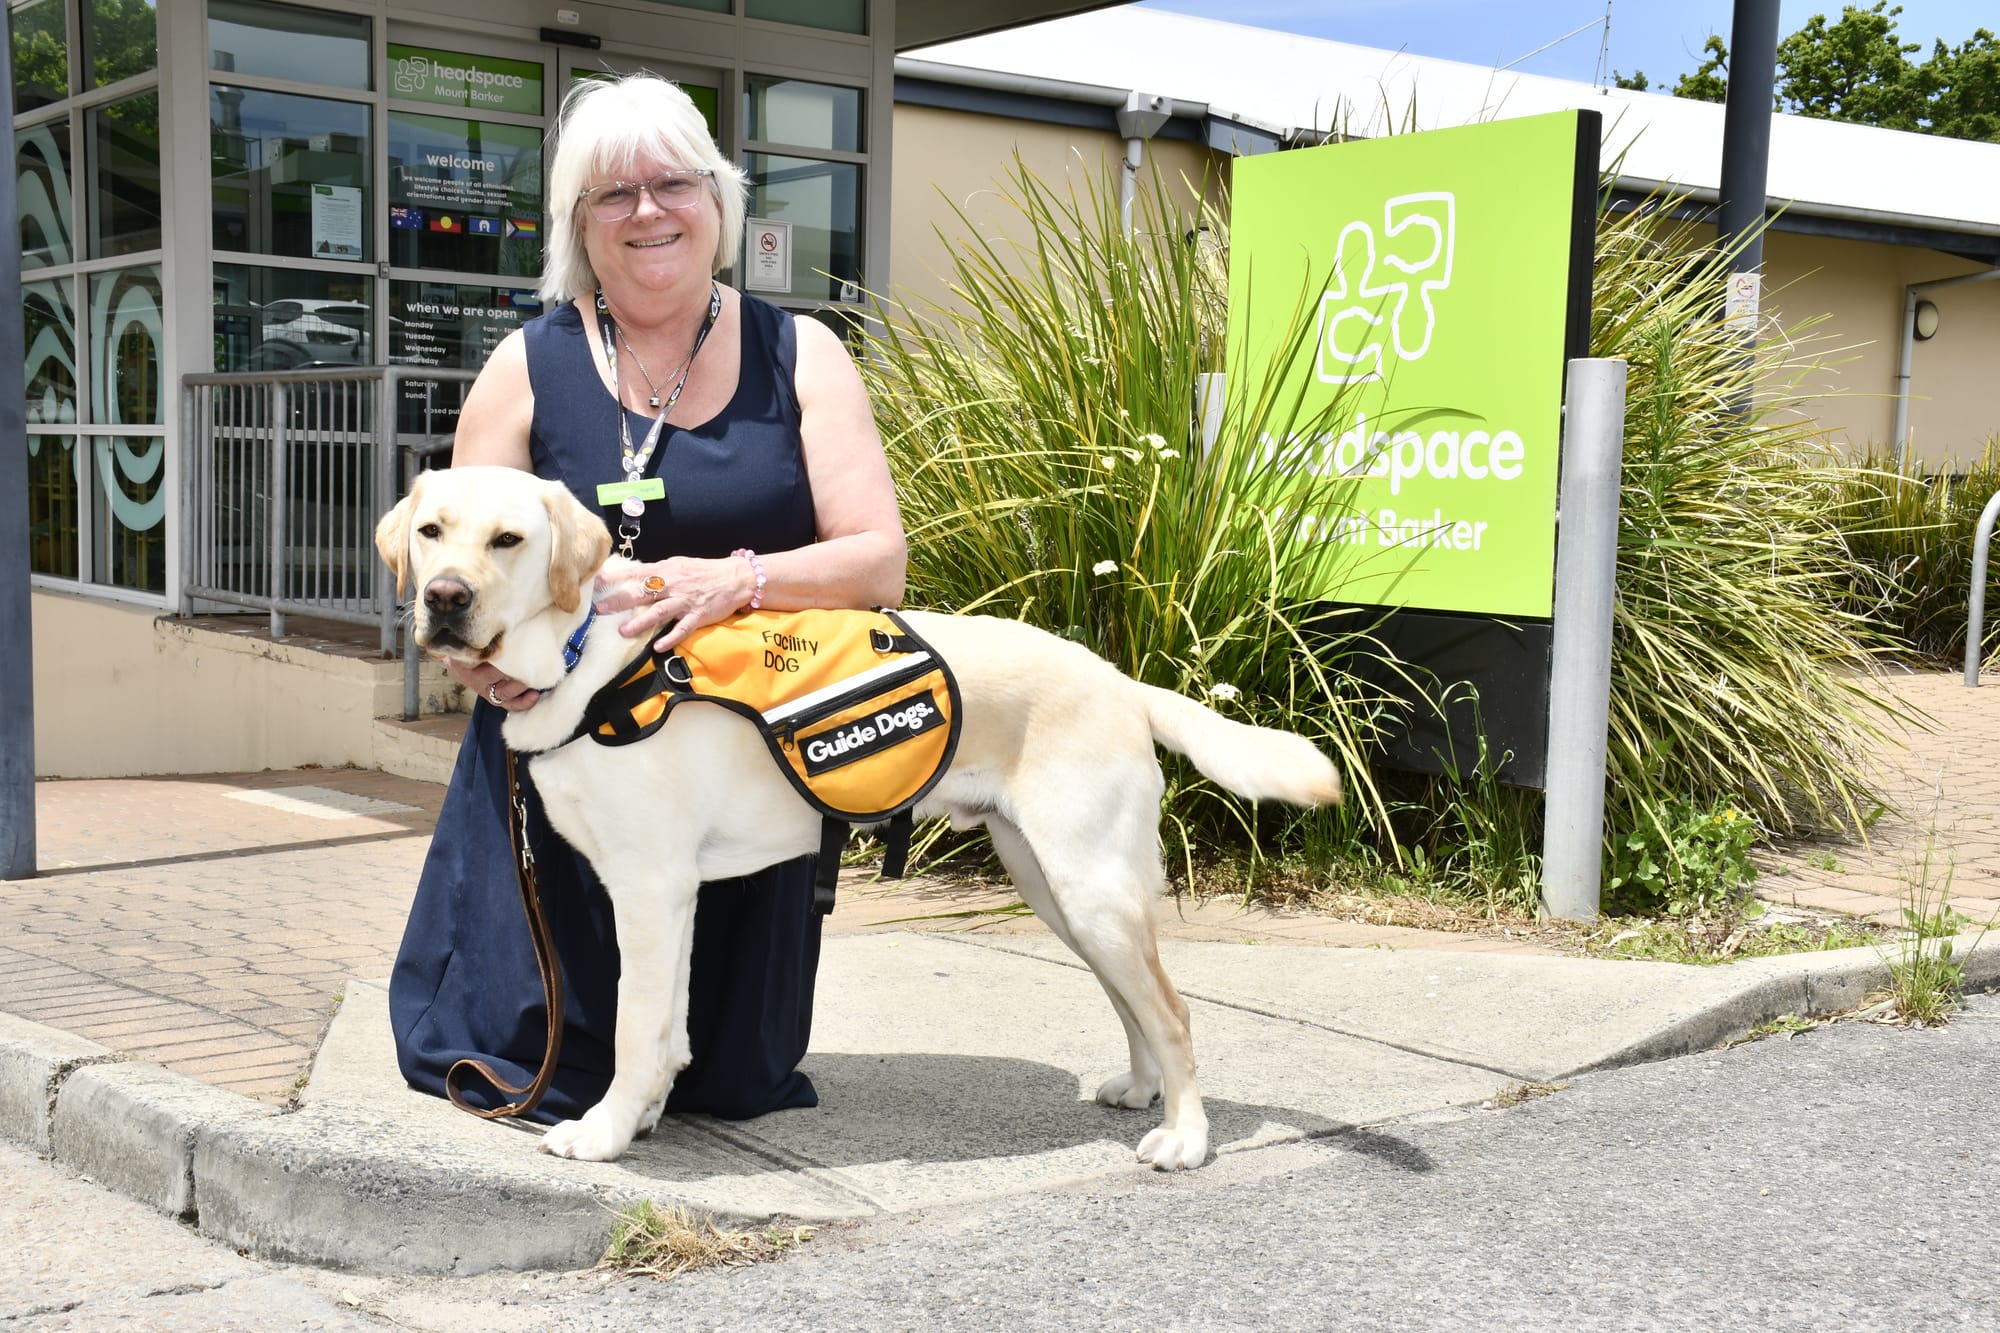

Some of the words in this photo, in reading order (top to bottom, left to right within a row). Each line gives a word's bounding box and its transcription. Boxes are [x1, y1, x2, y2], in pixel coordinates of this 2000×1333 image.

[434, 60, 523, 88] headspace
[434, 85, 468, 99] Mount
[470, 89, 504, 103] Barker
[426, 154, 496, 172] welcome
[414, 175, 442, 184] welcome
[443, 178, 465, 187] people
[406, 191, 446, 201] orientations
[446, 194, 459, 202] and
[460, 196, 483, 204] gender
[484, 197, 513, 207] identities
[414, 184, 439, 193] lifestyle
[487, 190, 507, 198] sexual
[406, 302, 440, 314] when
[442, 305, 460, 316] we
[462, 306, 484, 317] are
[487, 308, 517, 320] open
[405, 321, 434, 330] Monday
[405, 333, 435, 342] Tuesday
[405, 344, 447, 355] Wednesday
[1378, 507, 1488, 551] Barker
[762, 630, 819, 657] Facility
[764, 649, 800, 673] DOG
[806, 724, 877, 763] Guide
[874, 702, 935, 737] Dogs.
